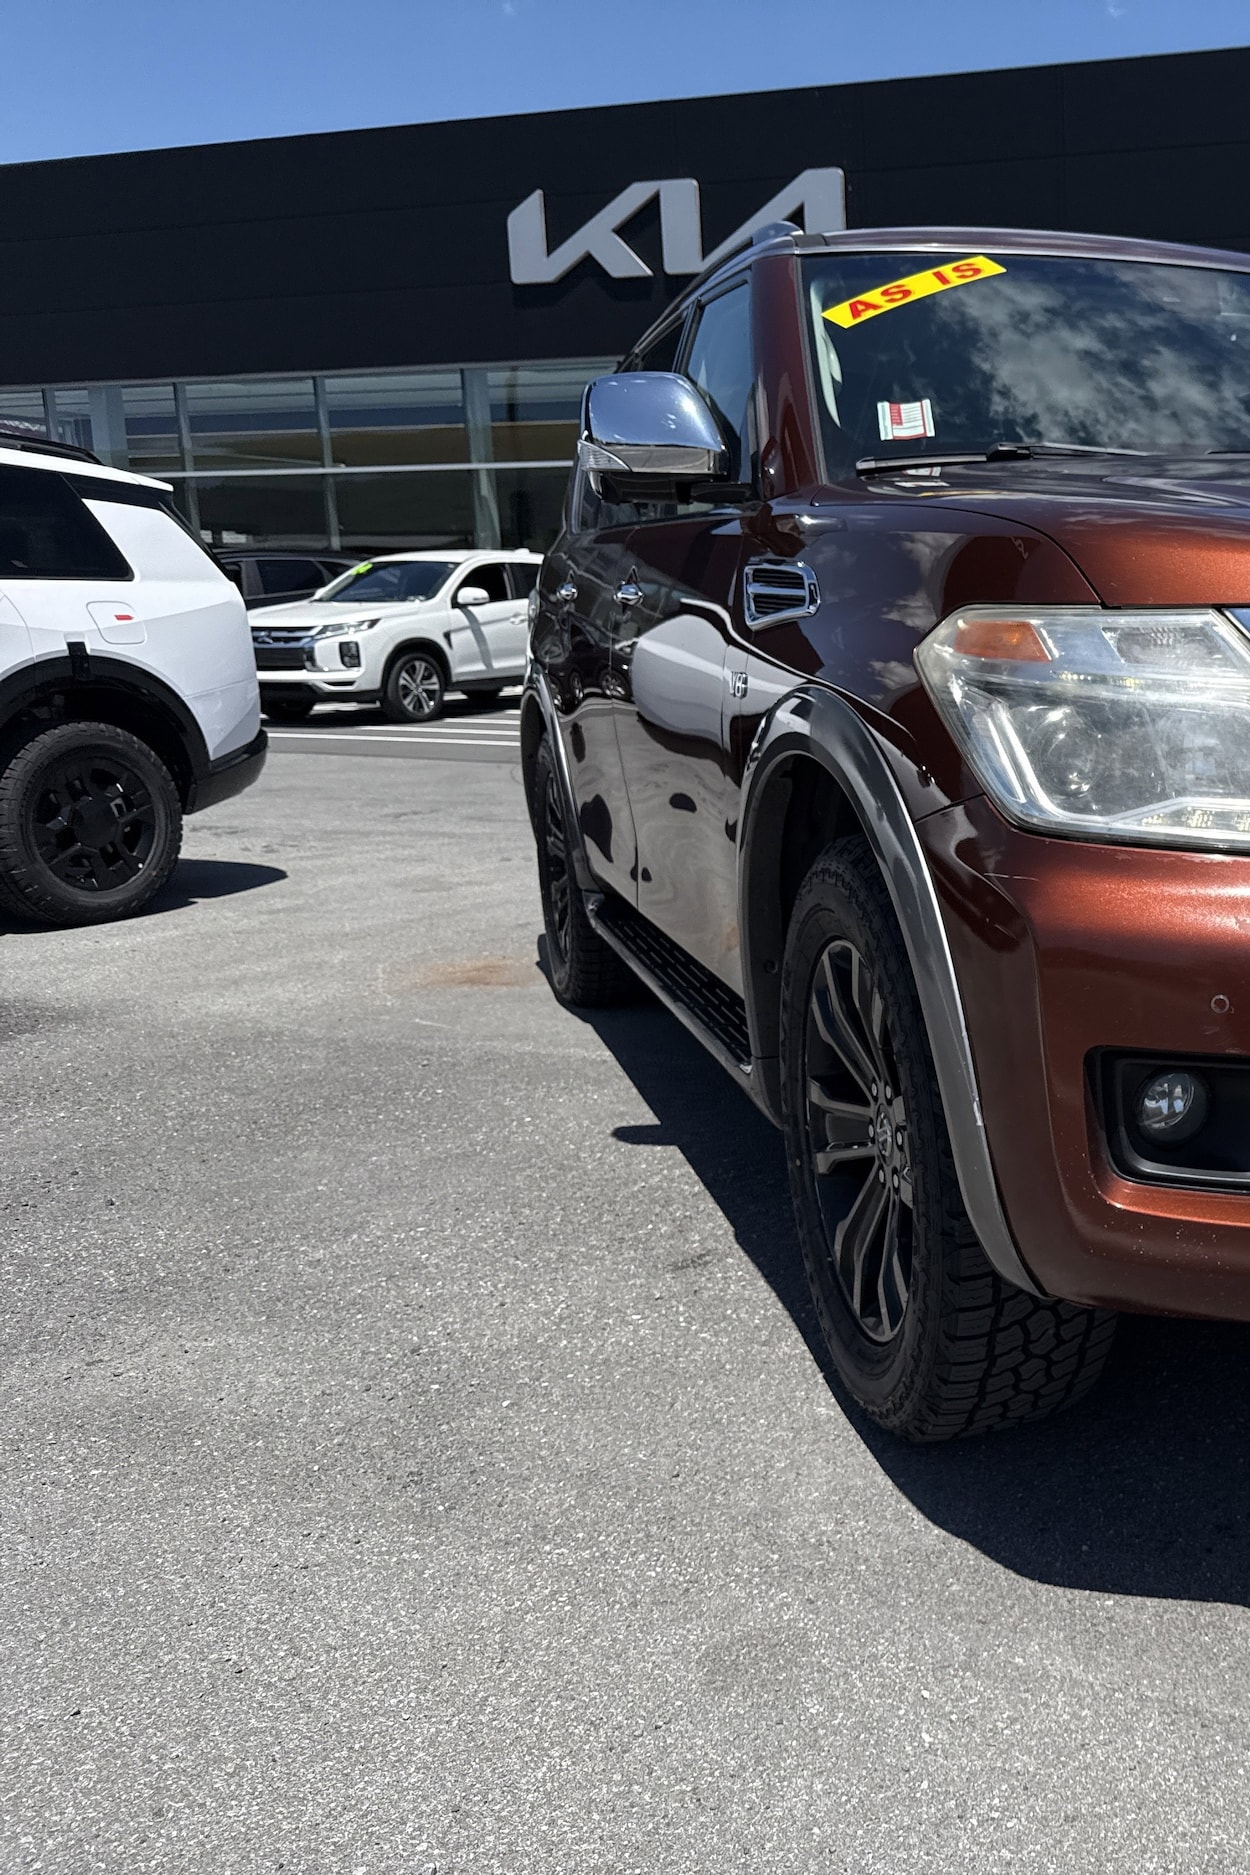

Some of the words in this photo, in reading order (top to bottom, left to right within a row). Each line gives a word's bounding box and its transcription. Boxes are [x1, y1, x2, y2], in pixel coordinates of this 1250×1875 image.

[506, 166, 845, 285] KIA
[848, 284, 914, 320] AS
[931, 262, 983, 287] IS
